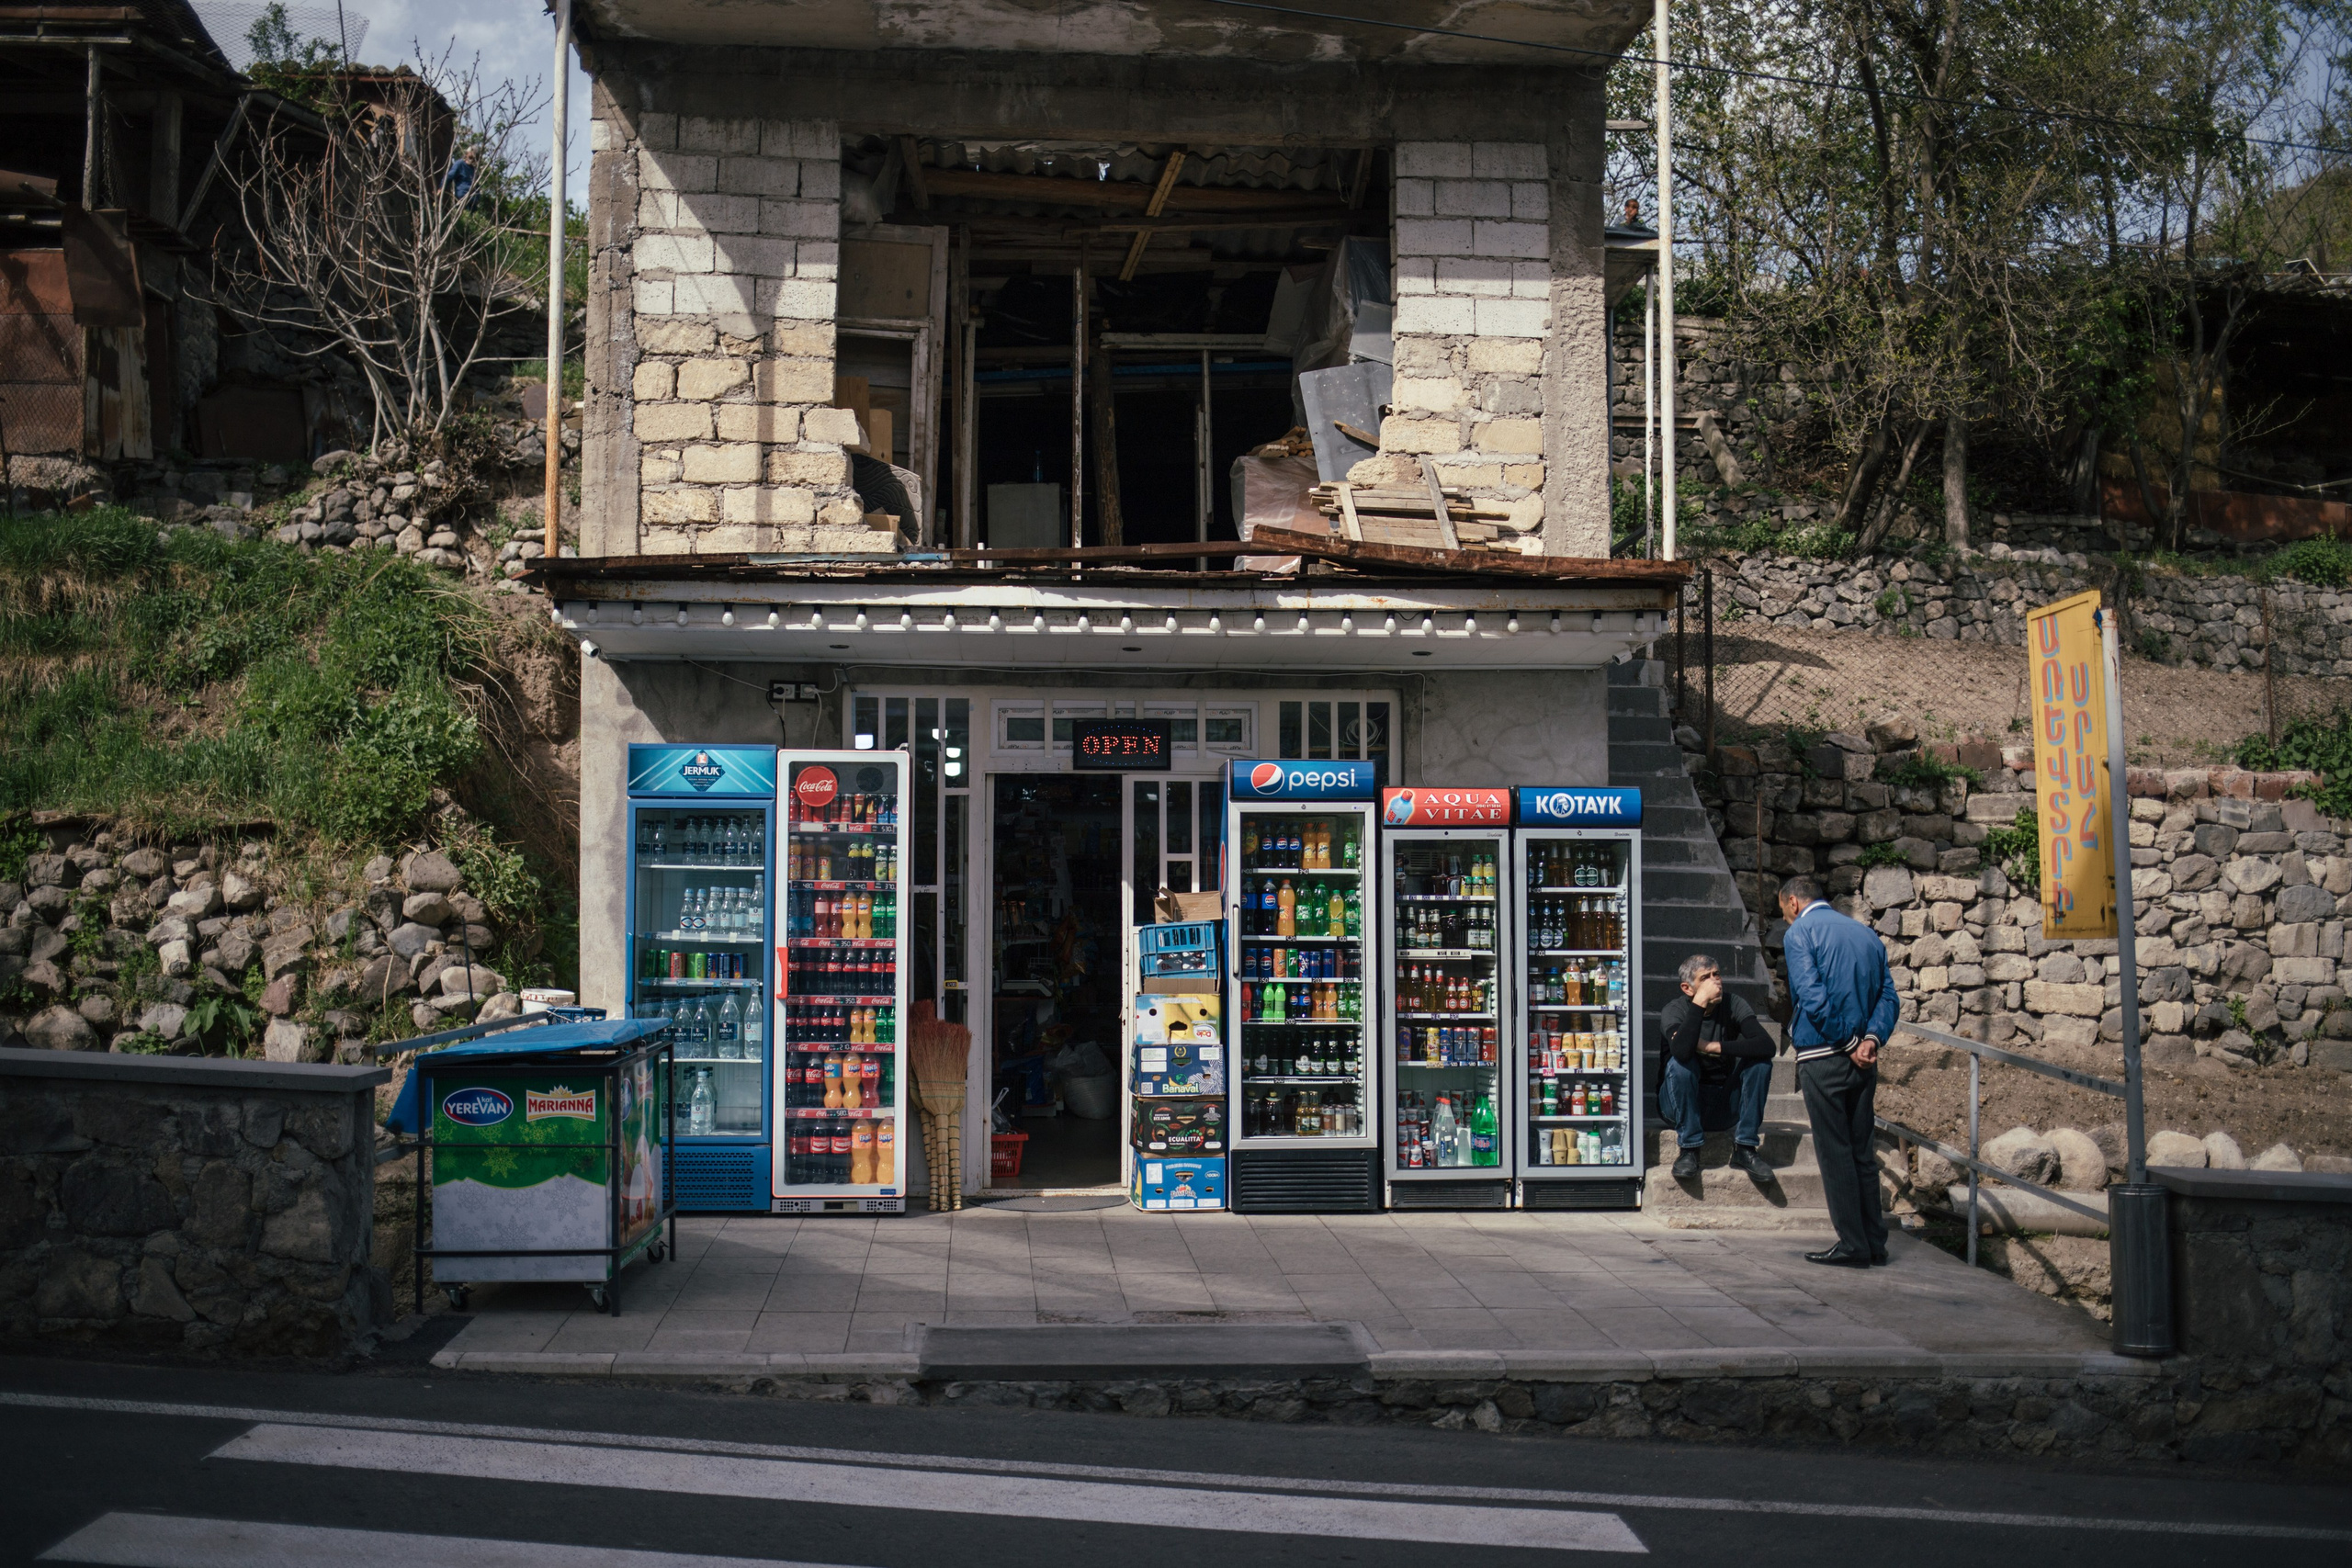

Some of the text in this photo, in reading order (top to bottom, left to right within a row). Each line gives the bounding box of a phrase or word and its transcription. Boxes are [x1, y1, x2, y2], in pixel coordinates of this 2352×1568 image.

[1082, 735, 1161, 755] OPEN
[683, 765, 720, 776] JERMUK
[1288, 768, 1355, 792] pepsi
[1424, 793, 1500, 807] AQUA
[1535, 792, 1623, 818] KOTAYK
[1424, 808, 1502, 819] VITAE
[1162, 1083, 1199, 1093] Banaval
[447, 1097, 507, 1114] YEREVAN
[528, 1097, 594, 1113] MARIANNA
